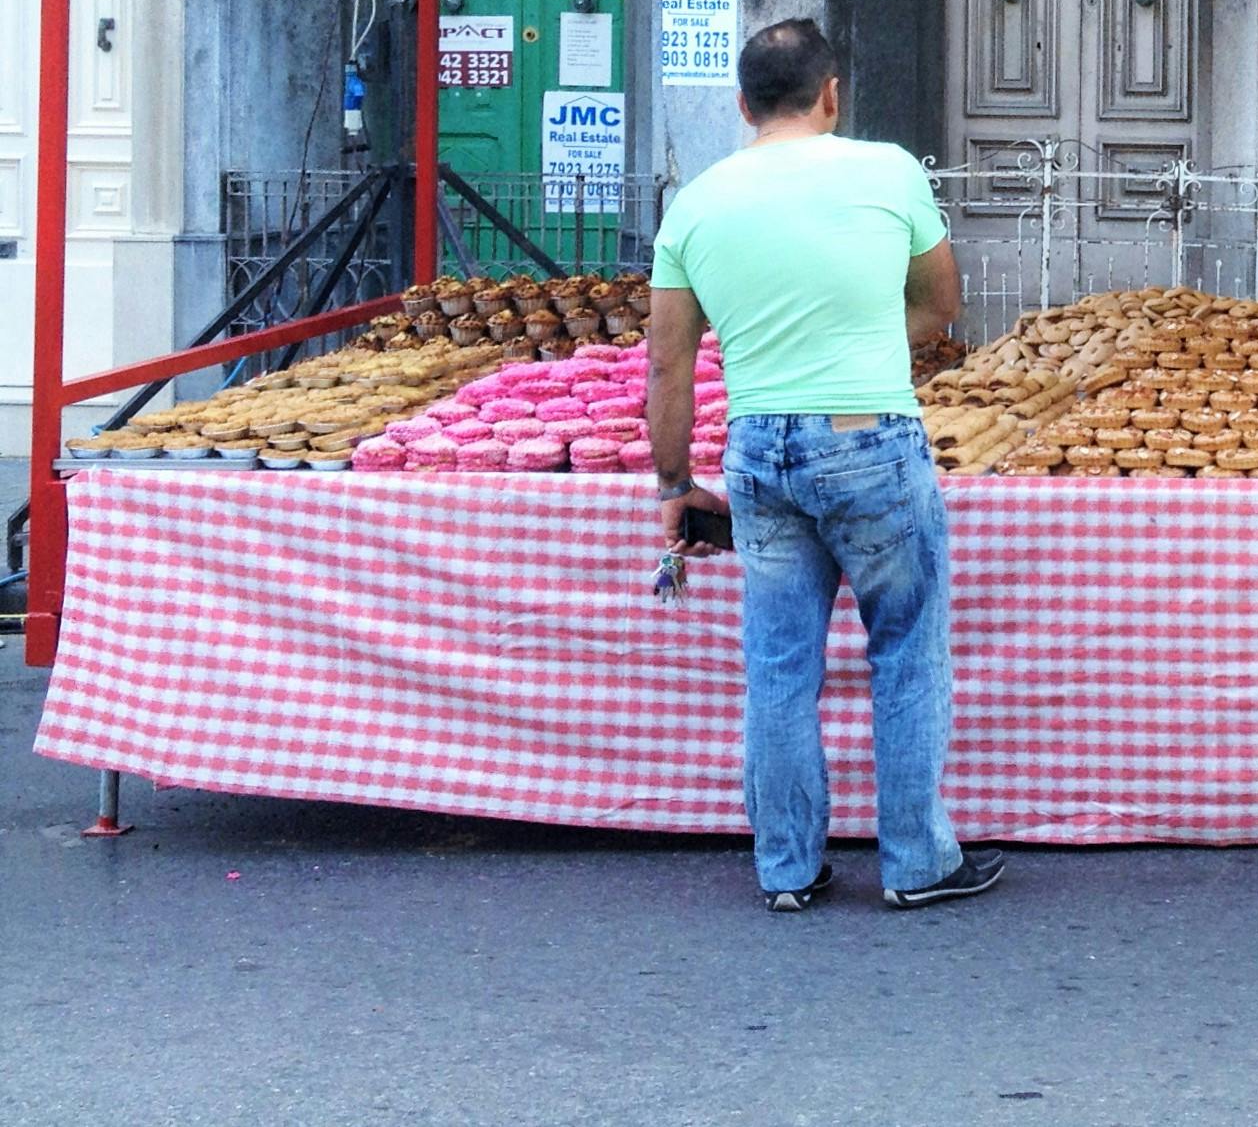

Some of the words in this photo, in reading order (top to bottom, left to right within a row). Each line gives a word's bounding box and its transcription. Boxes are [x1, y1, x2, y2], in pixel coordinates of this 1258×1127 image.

[673, 18, 688, 27] FOR
[690, 18, 710, 27] SALE
[439, 25, 507, 39] PACT
[695, 32, 729, 48] 1275
[468, 54, 509, 68] 3321
[694, 52, 729, 68] 0819
[468, 70, 509, 85] 3321
[549, 106, 621, 126] JMC
[549, 131, 577, 143] Real
[581, 132, 621, 144] Estate
[568, 150, 582, 159] FOR
[584, 150, 602, 159] SALE
[549, 162, 582, 177] 7923
[588, 163, 620, 178] 1275
[587, 181, 620, 196] 0819
